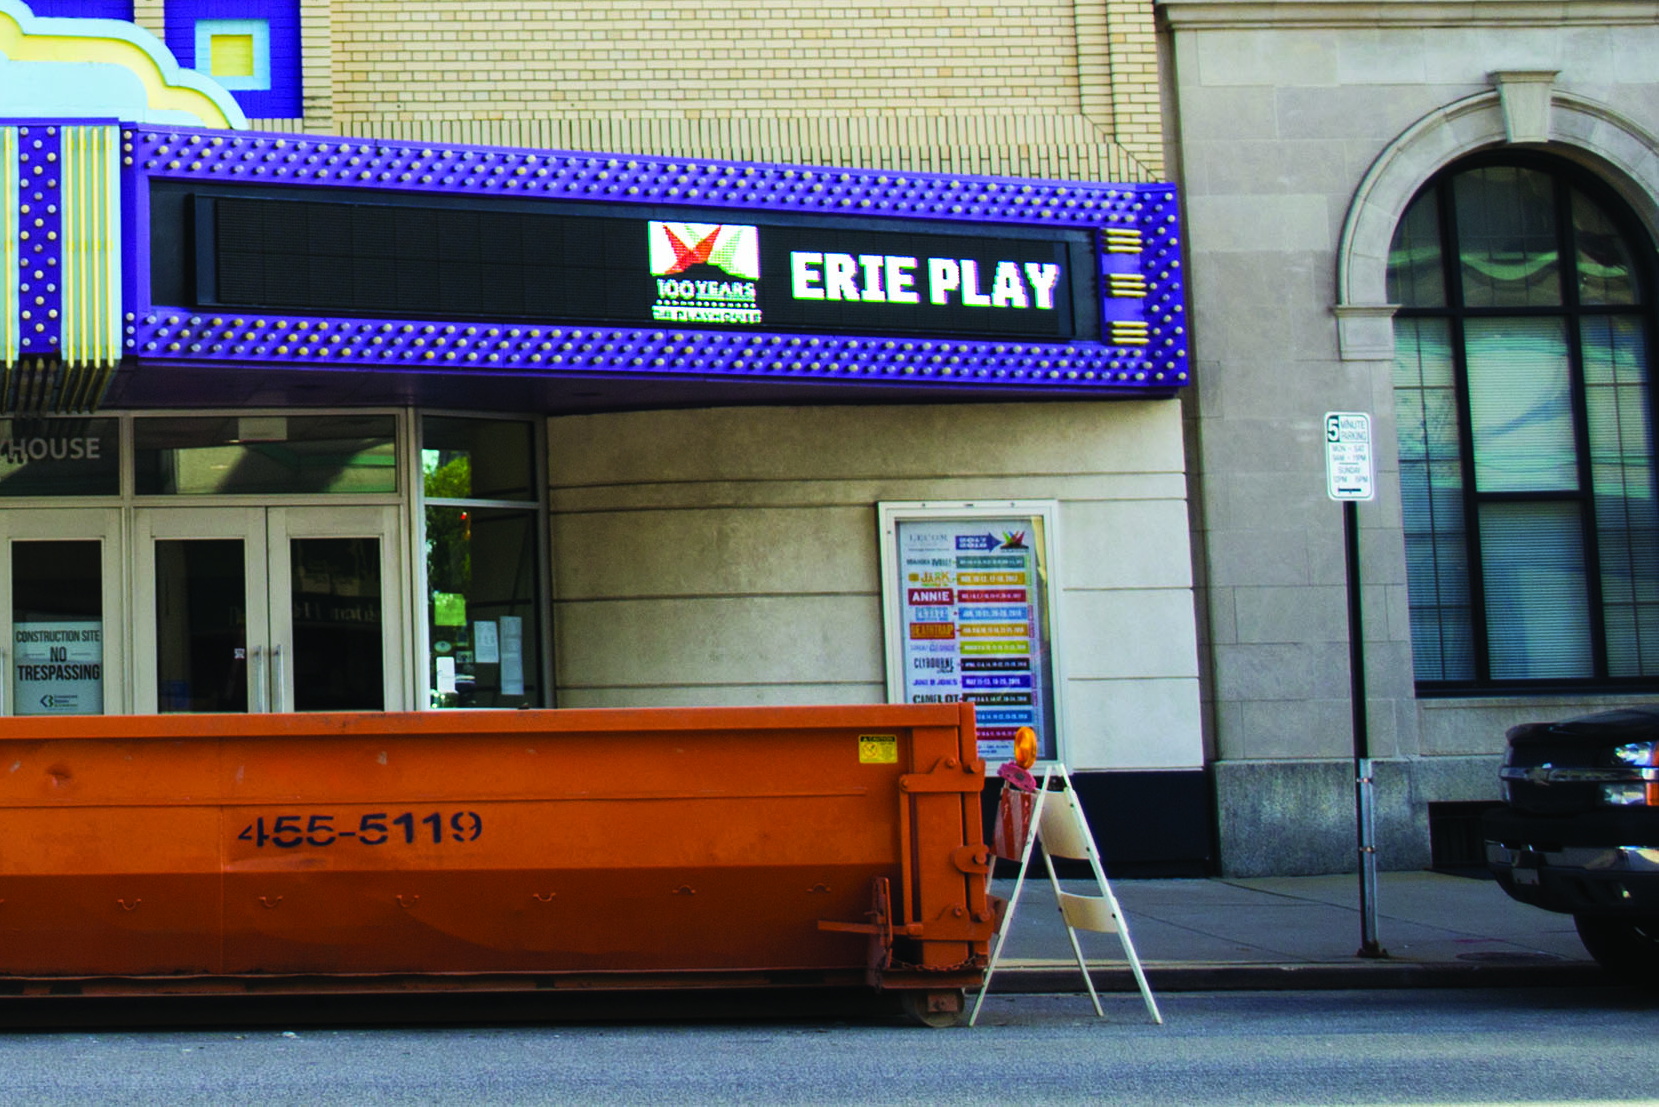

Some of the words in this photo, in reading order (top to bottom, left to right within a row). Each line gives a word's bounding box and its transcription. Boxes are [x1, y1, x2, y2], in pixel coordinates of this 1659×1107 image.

[790, 251, 920, 304] ERIE
[928, 256, 1060, 310] PLAY
[656, 278, 695, 300] 100
[694, 279, 757, 301] YEARS
[1328, 419, 1339, 441] 5
[1341, 420, 1366, 430] MINUTE
[1342, 431, 1367, 440] PARKING
[912, 591, 950, 602] ANNIE
[16, 630, 80, 643] CONSTRUCTION
[82, 630, 101, 642] SITE
[50, 646, 67, 662] NO
[18, 664, 101, 681] TRESPASSING
[238, 810, 485, 849] 455-5119
